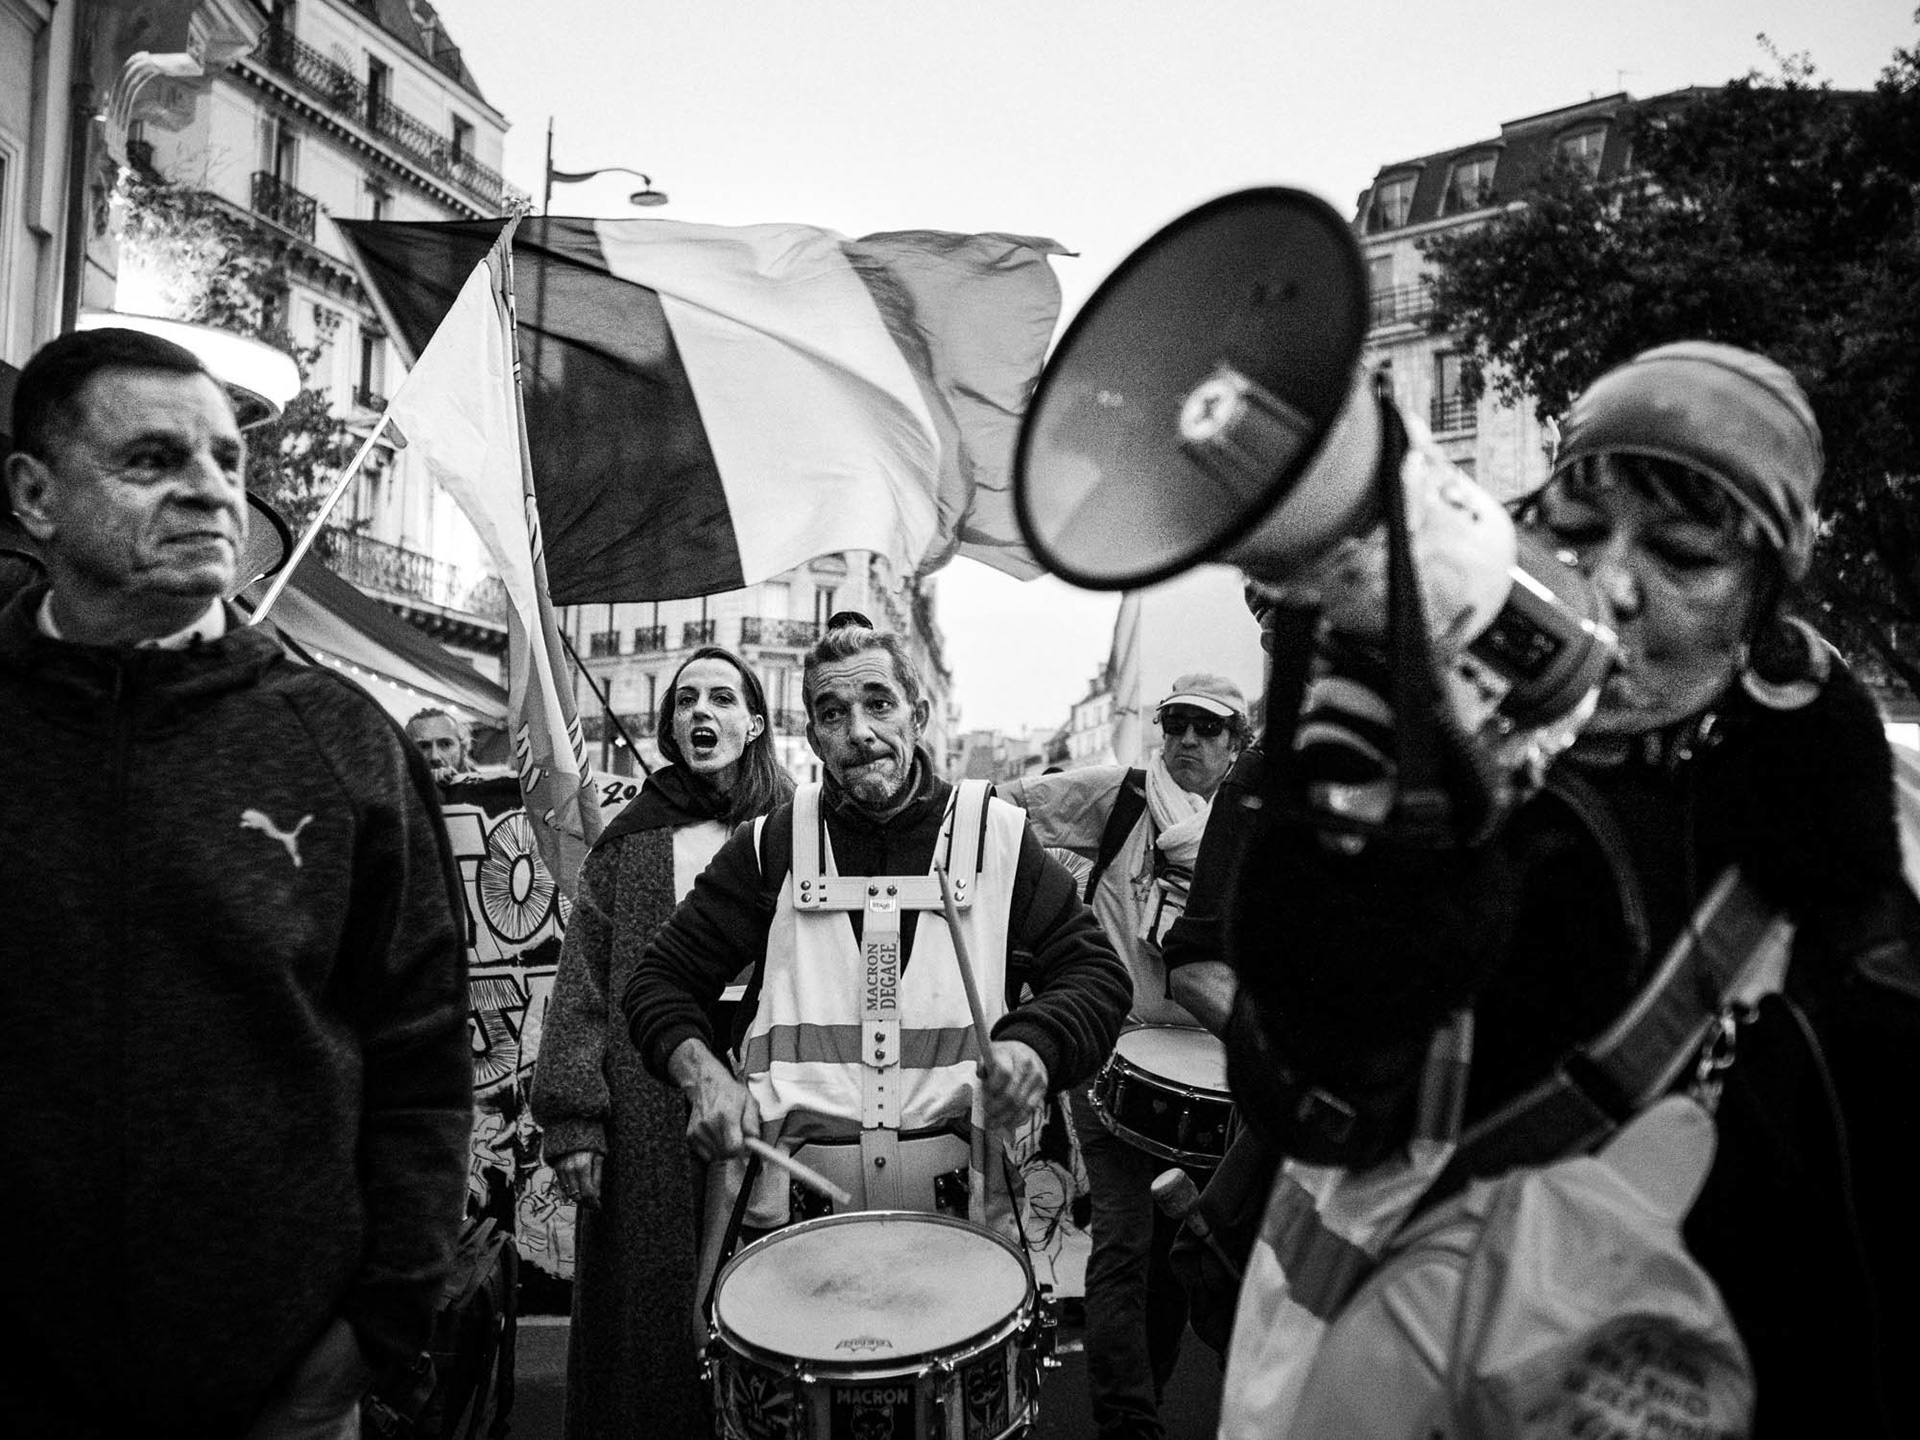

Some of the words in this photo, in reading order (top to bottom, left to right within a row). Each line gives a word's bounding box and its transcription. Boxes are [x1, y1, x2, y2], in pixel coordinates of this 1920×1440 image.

[866, 942, 879, 1011] MACRON
[880, 942, 897, 1010] DEGAGE
[836, 1386, 909, 1406] MACRON
